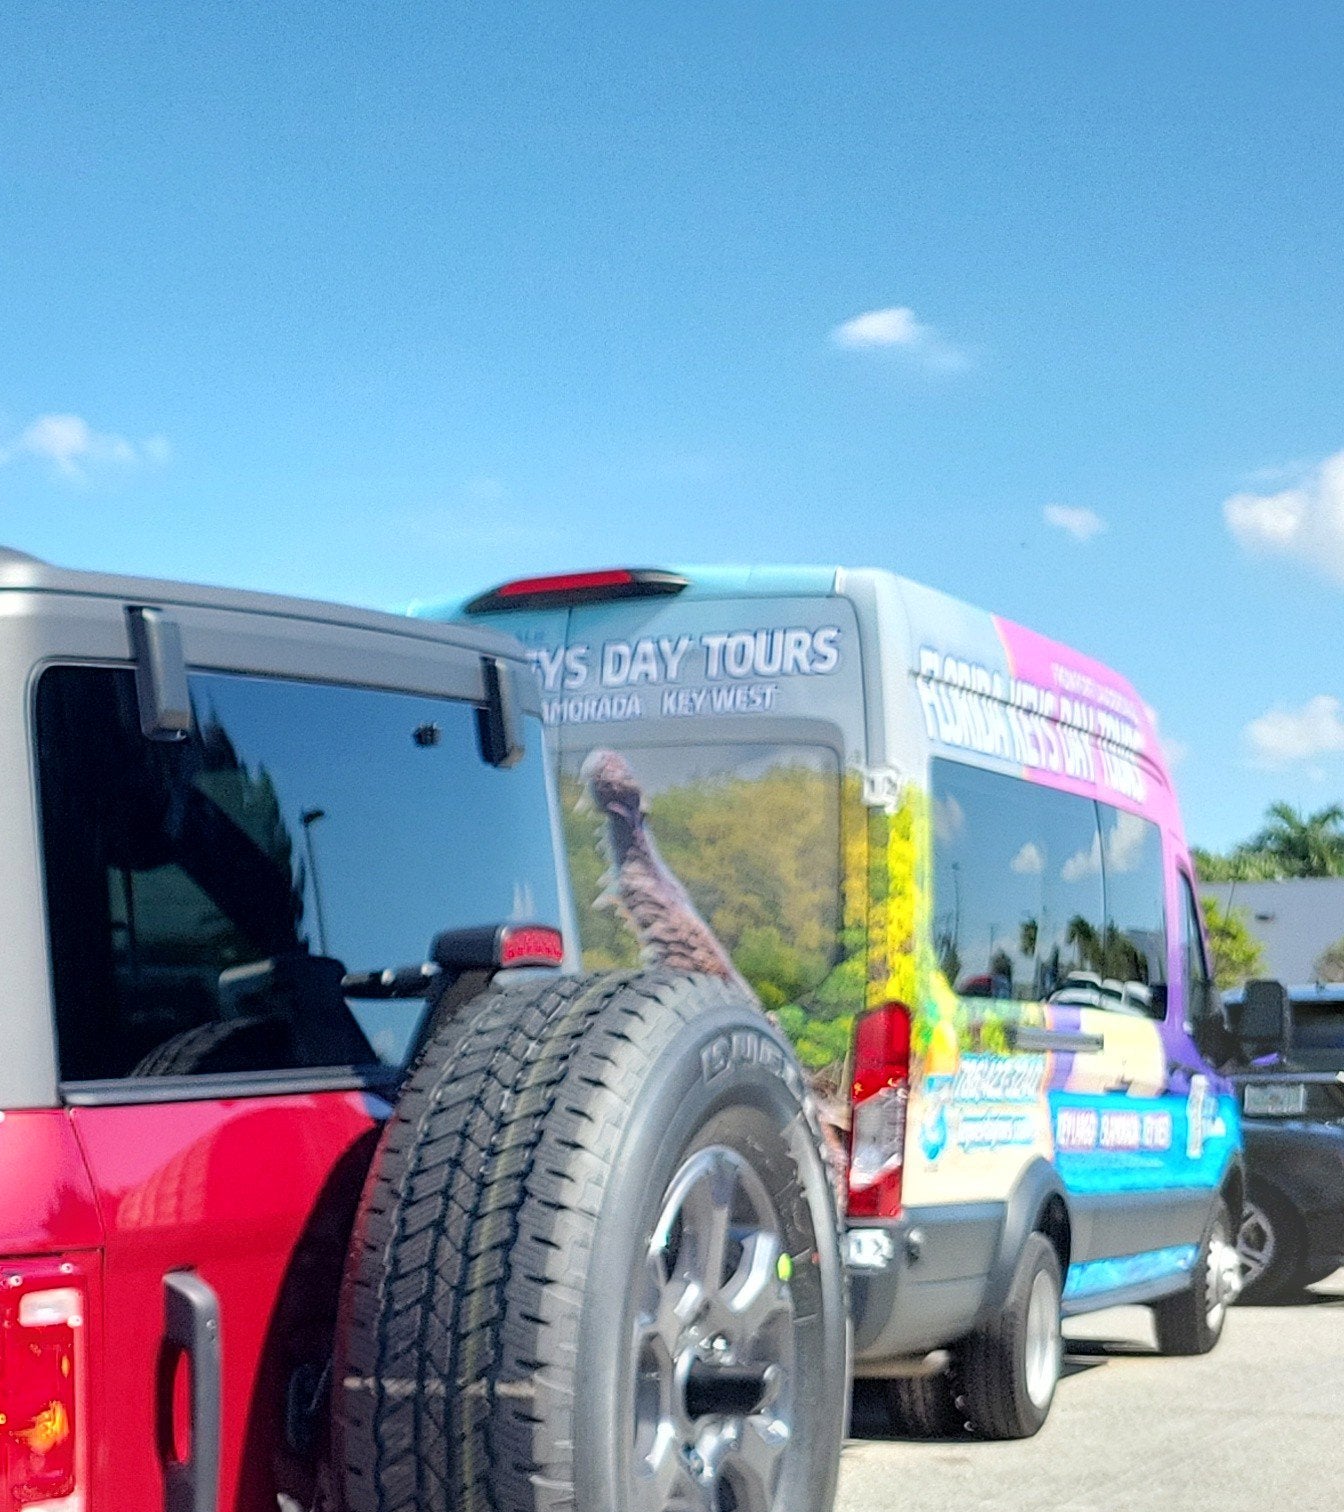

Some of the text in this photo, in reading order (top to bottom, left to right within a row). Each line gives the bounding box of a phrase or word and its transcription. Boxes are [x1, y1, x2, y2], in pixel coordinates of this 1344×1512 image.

[525, 625, 841, 692] YS DAY TOURS
[663, 688, 711, 716] KEY
[713, 684, 778, 713] WEST
